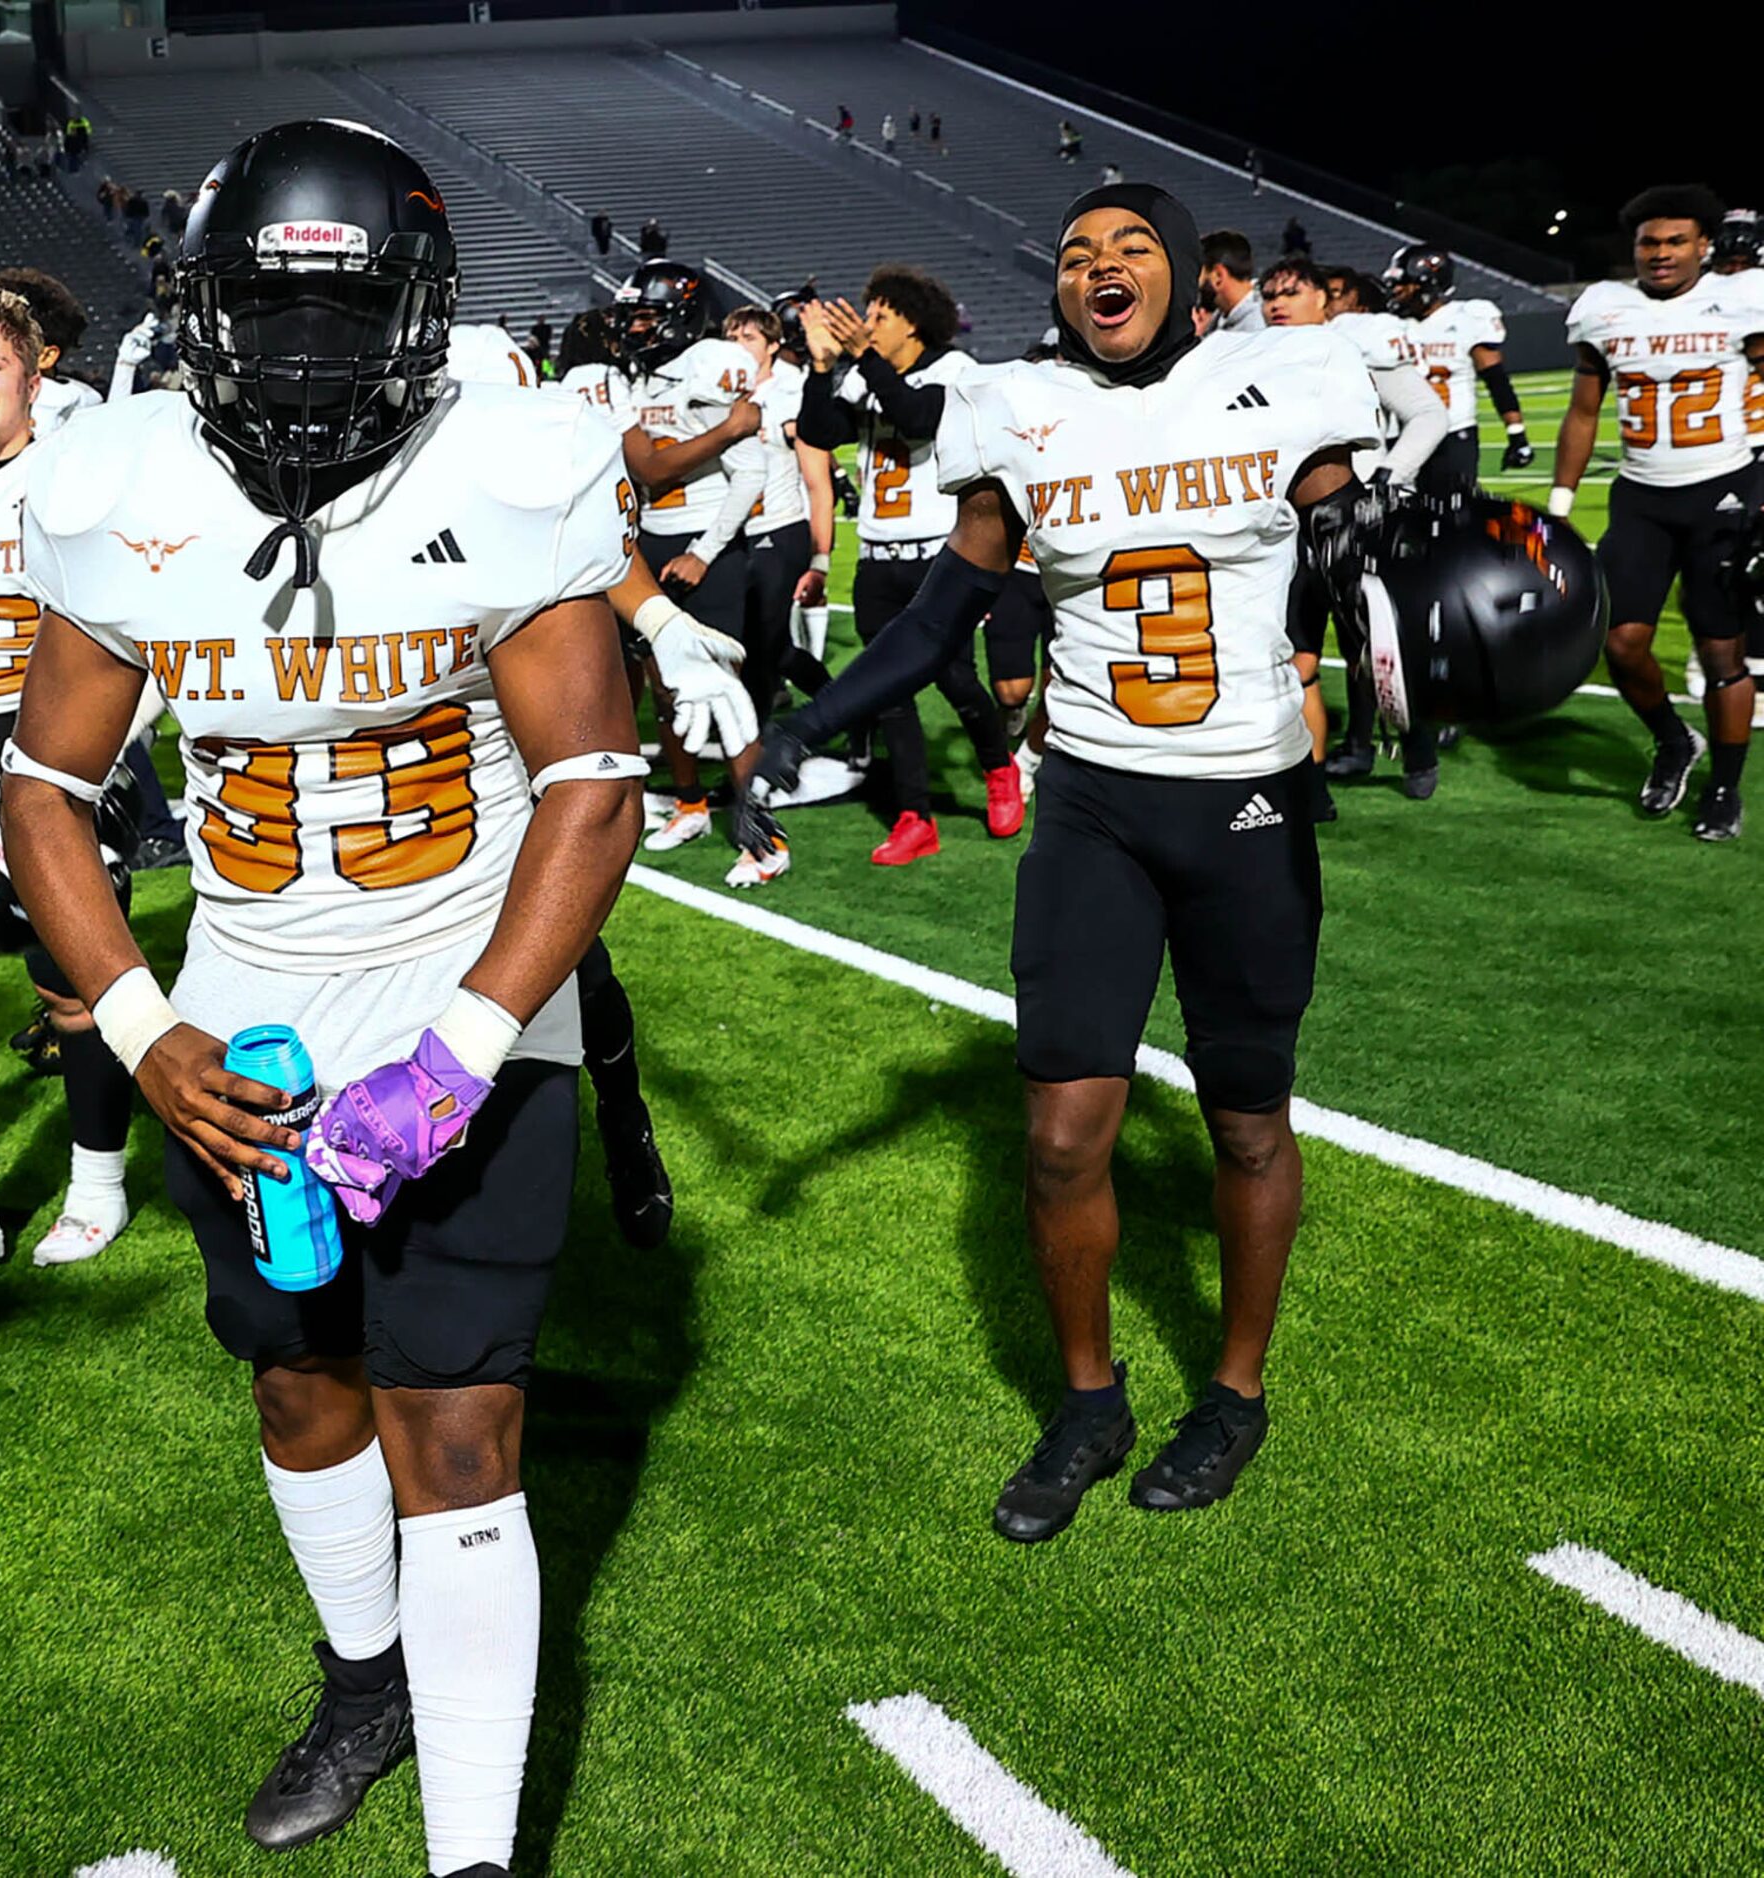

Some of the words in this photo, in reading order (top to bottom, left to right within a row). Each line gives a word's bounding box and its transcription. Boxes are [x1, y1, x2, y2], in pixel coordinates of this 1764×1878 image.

[149, 37, 166, 58] E
[283, 226, 343, 243] Riddell
[1648, 332, 1730, 355] WHITE
[1617, 367, 1723, 449] 32
[1025, 475, 1101, 529] W.T.
[1116, 449, 1279, 516] WHITE
[1098, 542, 1220, 728] 3
[136, 638, 245, 700] W.T.
[264, 623, 480, 703] WHITE
[1230, 810, 1284, 832] adidas
